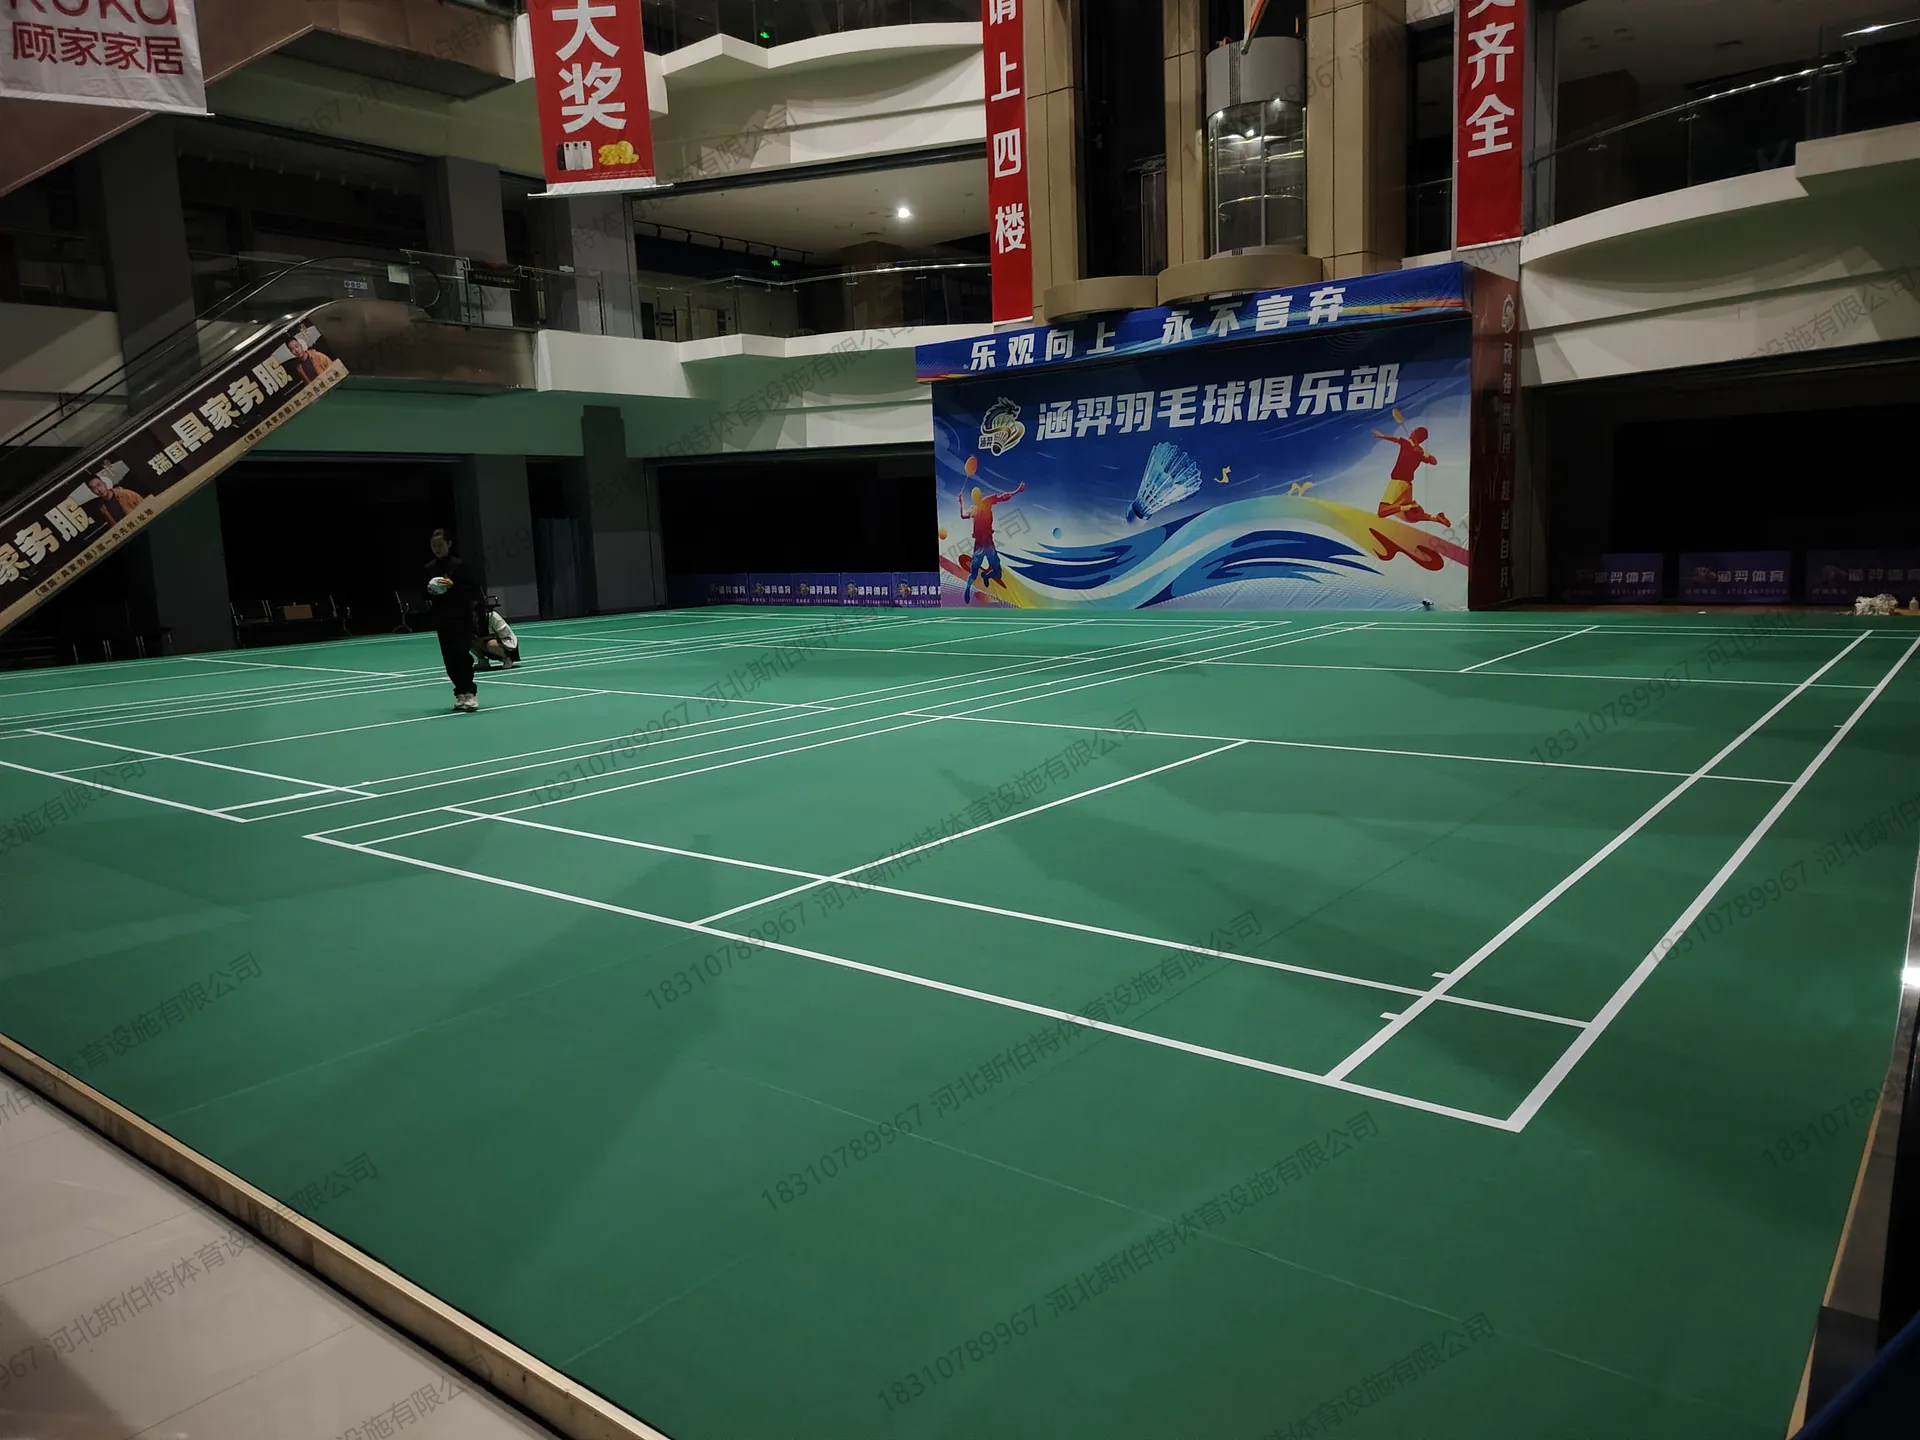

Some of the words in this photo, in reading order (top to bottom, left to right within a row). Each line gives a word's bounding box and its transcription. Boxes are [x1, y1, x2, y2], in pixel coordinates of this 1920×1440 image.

[11, 21, 185, 75] 顾家家居
[551, 0, 628, 134] 大奖
[969, 320, 1118, 372] 乐观向上
[1161, 285, 1348, 347] 永不言弃
[1035, 362, 1403, 443] 涵羿羽毛球俱乐部
[1716, 569, 1785, 583] 涵羿体育
